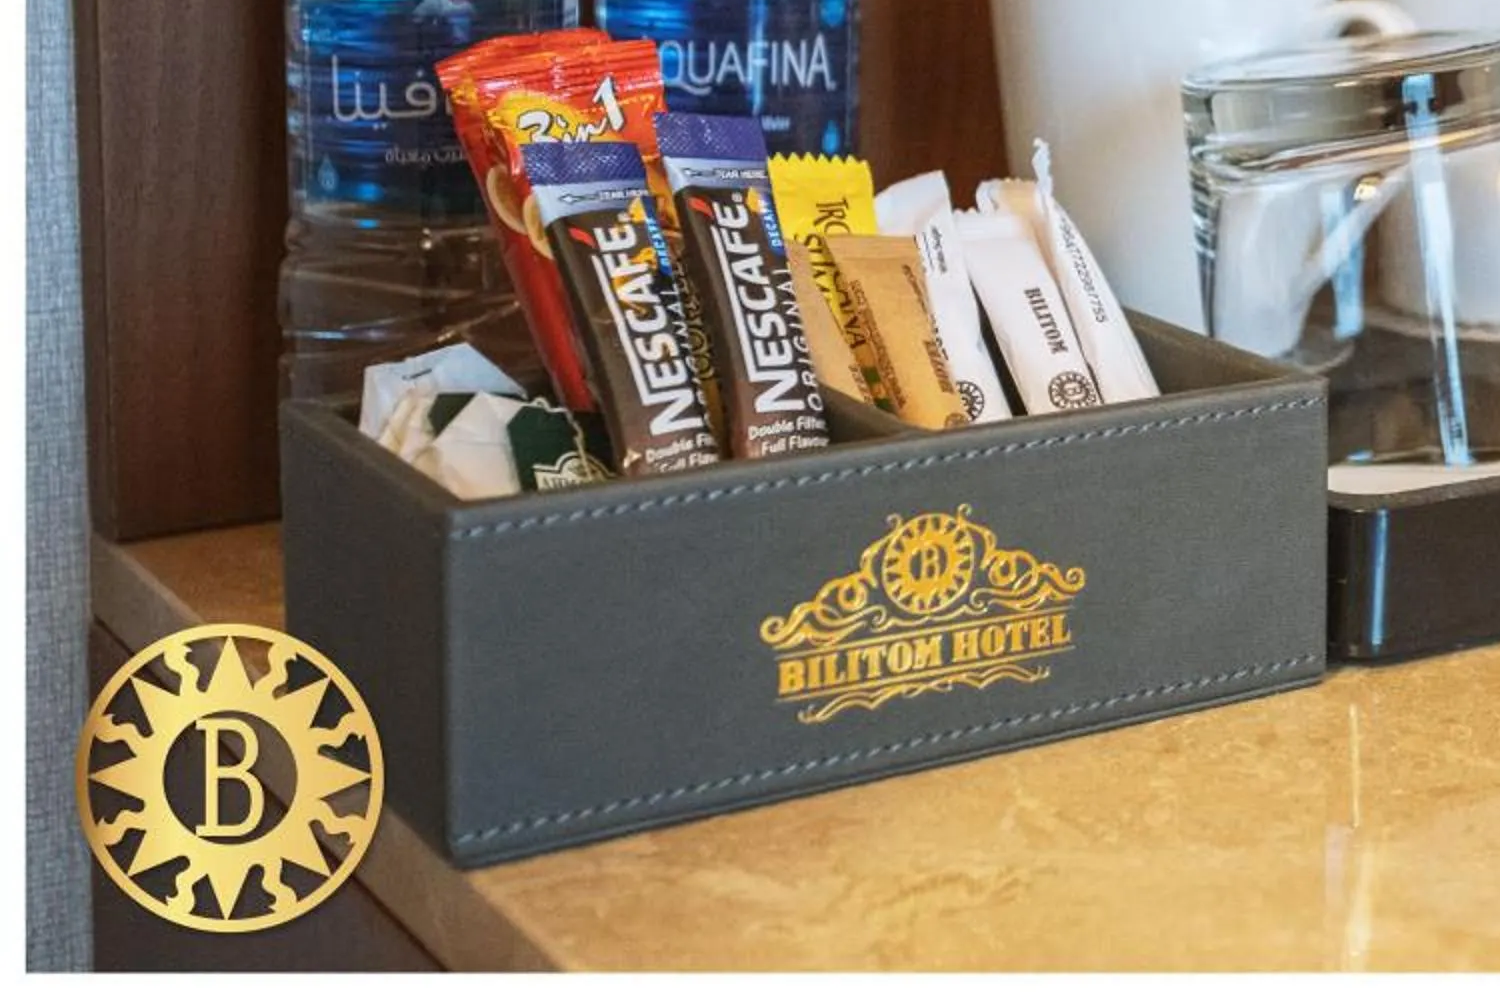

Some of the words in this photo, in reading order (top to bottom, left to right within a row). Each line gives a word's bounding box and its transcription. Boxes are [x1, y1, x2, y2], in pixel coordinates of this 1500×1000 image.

[658, 31, 837, 95] QUAFINA
[1024, 285, 1070, 356] BILITOM
[778, 635, 943, 696] BILITOM
[952, 613, 1072, 663] HOTEL
